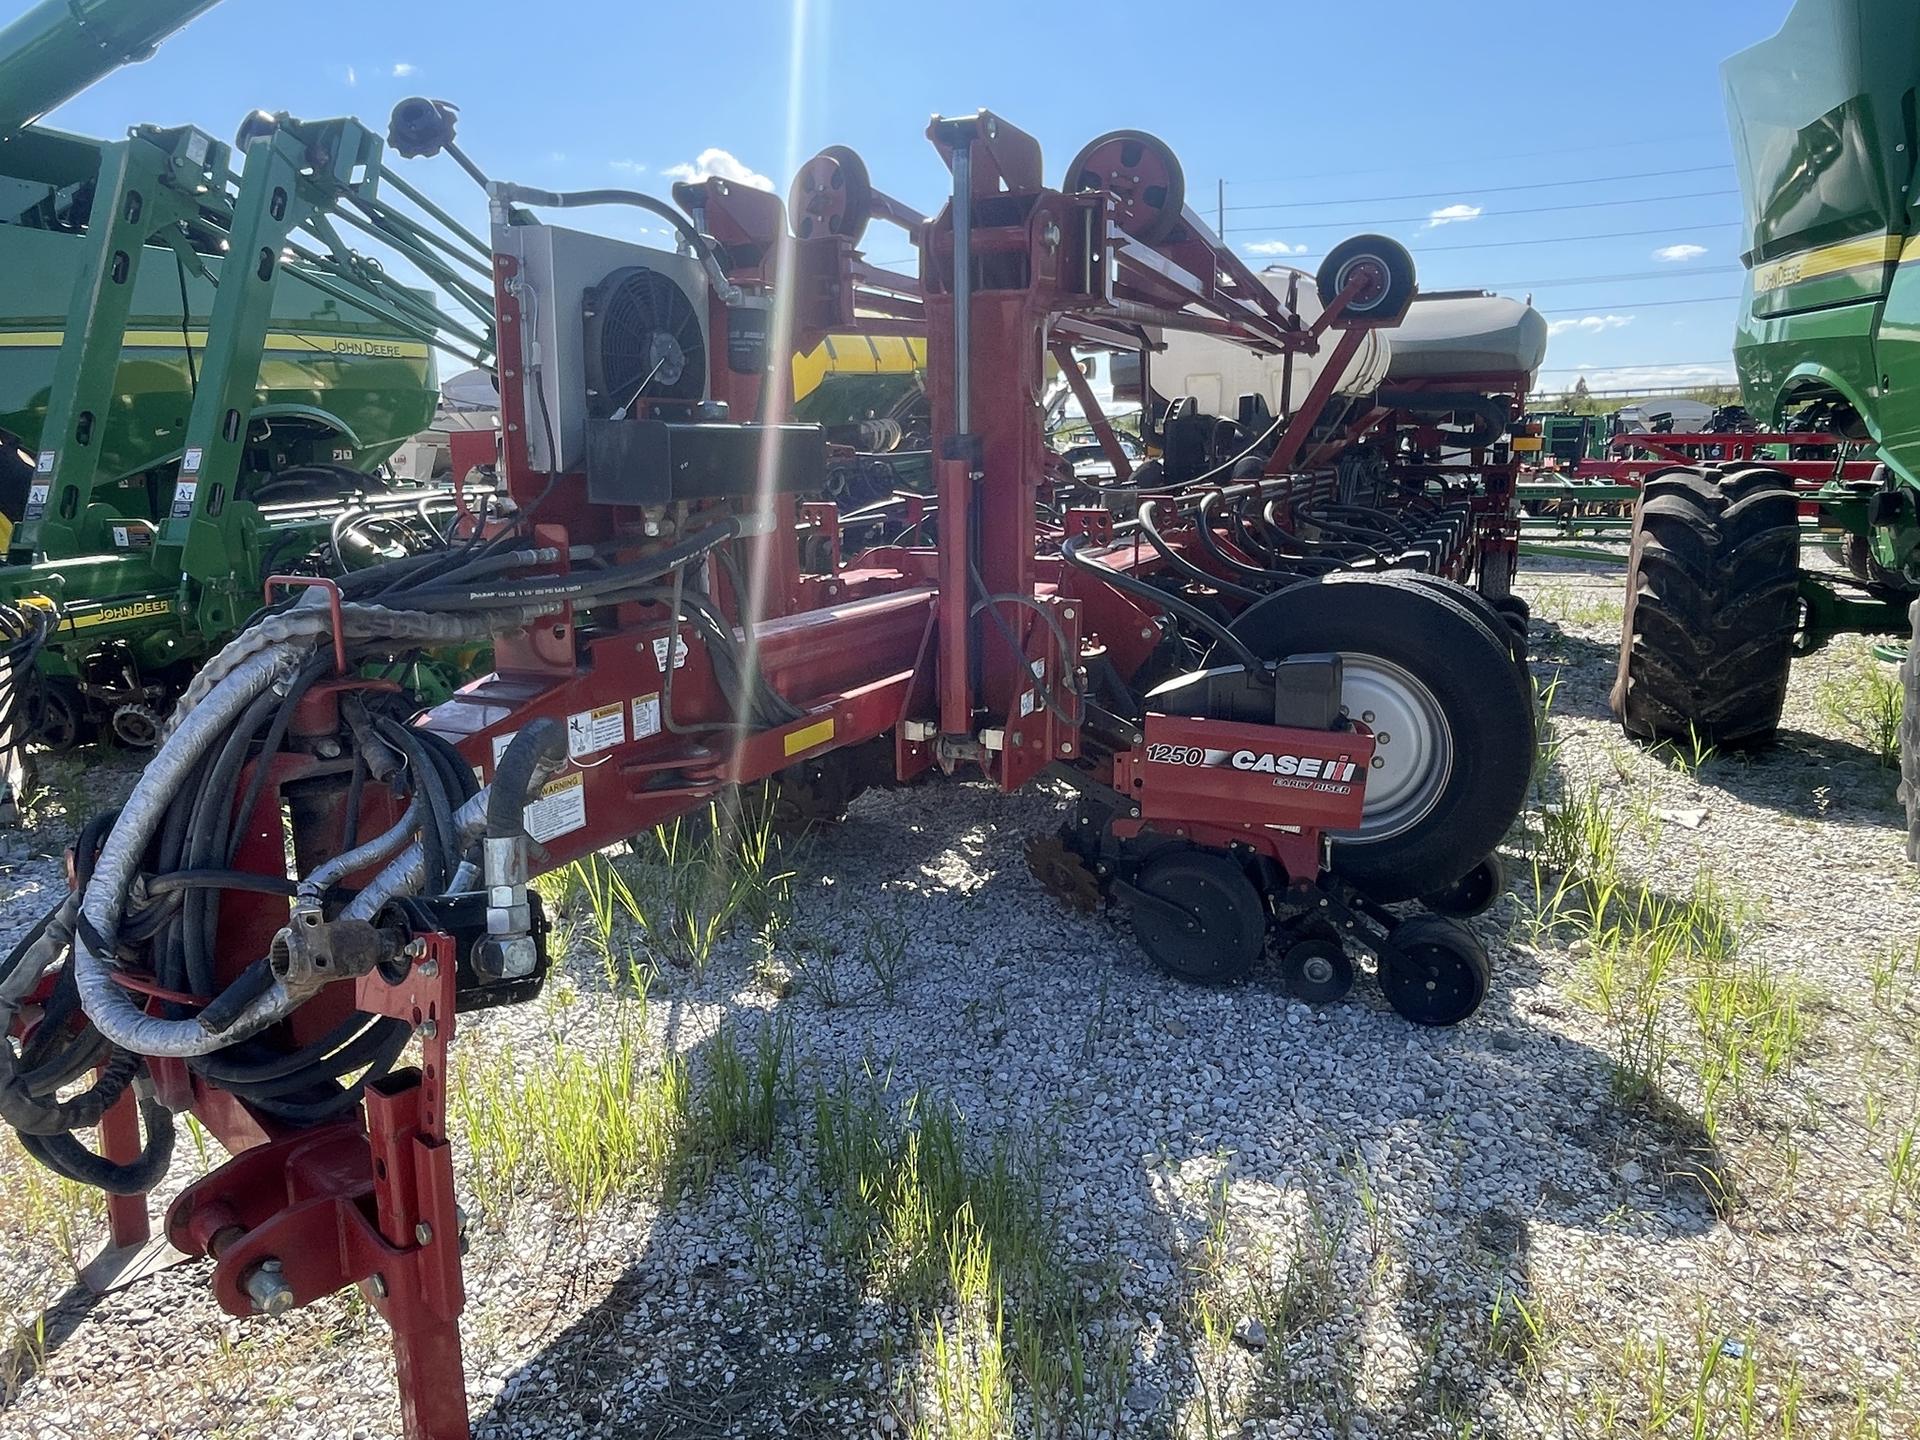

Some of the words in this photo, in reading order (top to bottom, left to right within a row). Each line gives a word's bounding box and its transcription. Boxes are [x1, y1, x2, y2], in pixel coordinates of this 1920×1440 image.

[332, 339, 363, 353] JOHN
[364, 341, 401, 356] DEERE
[97, 606, 133, 621] JOHN
[133, 600, 169, 614] DEER
[1147, 743, 1205, 768] 1250
[1232, 750, 1323, 779] CASE
[542, 776, 579, 795] WARNING
